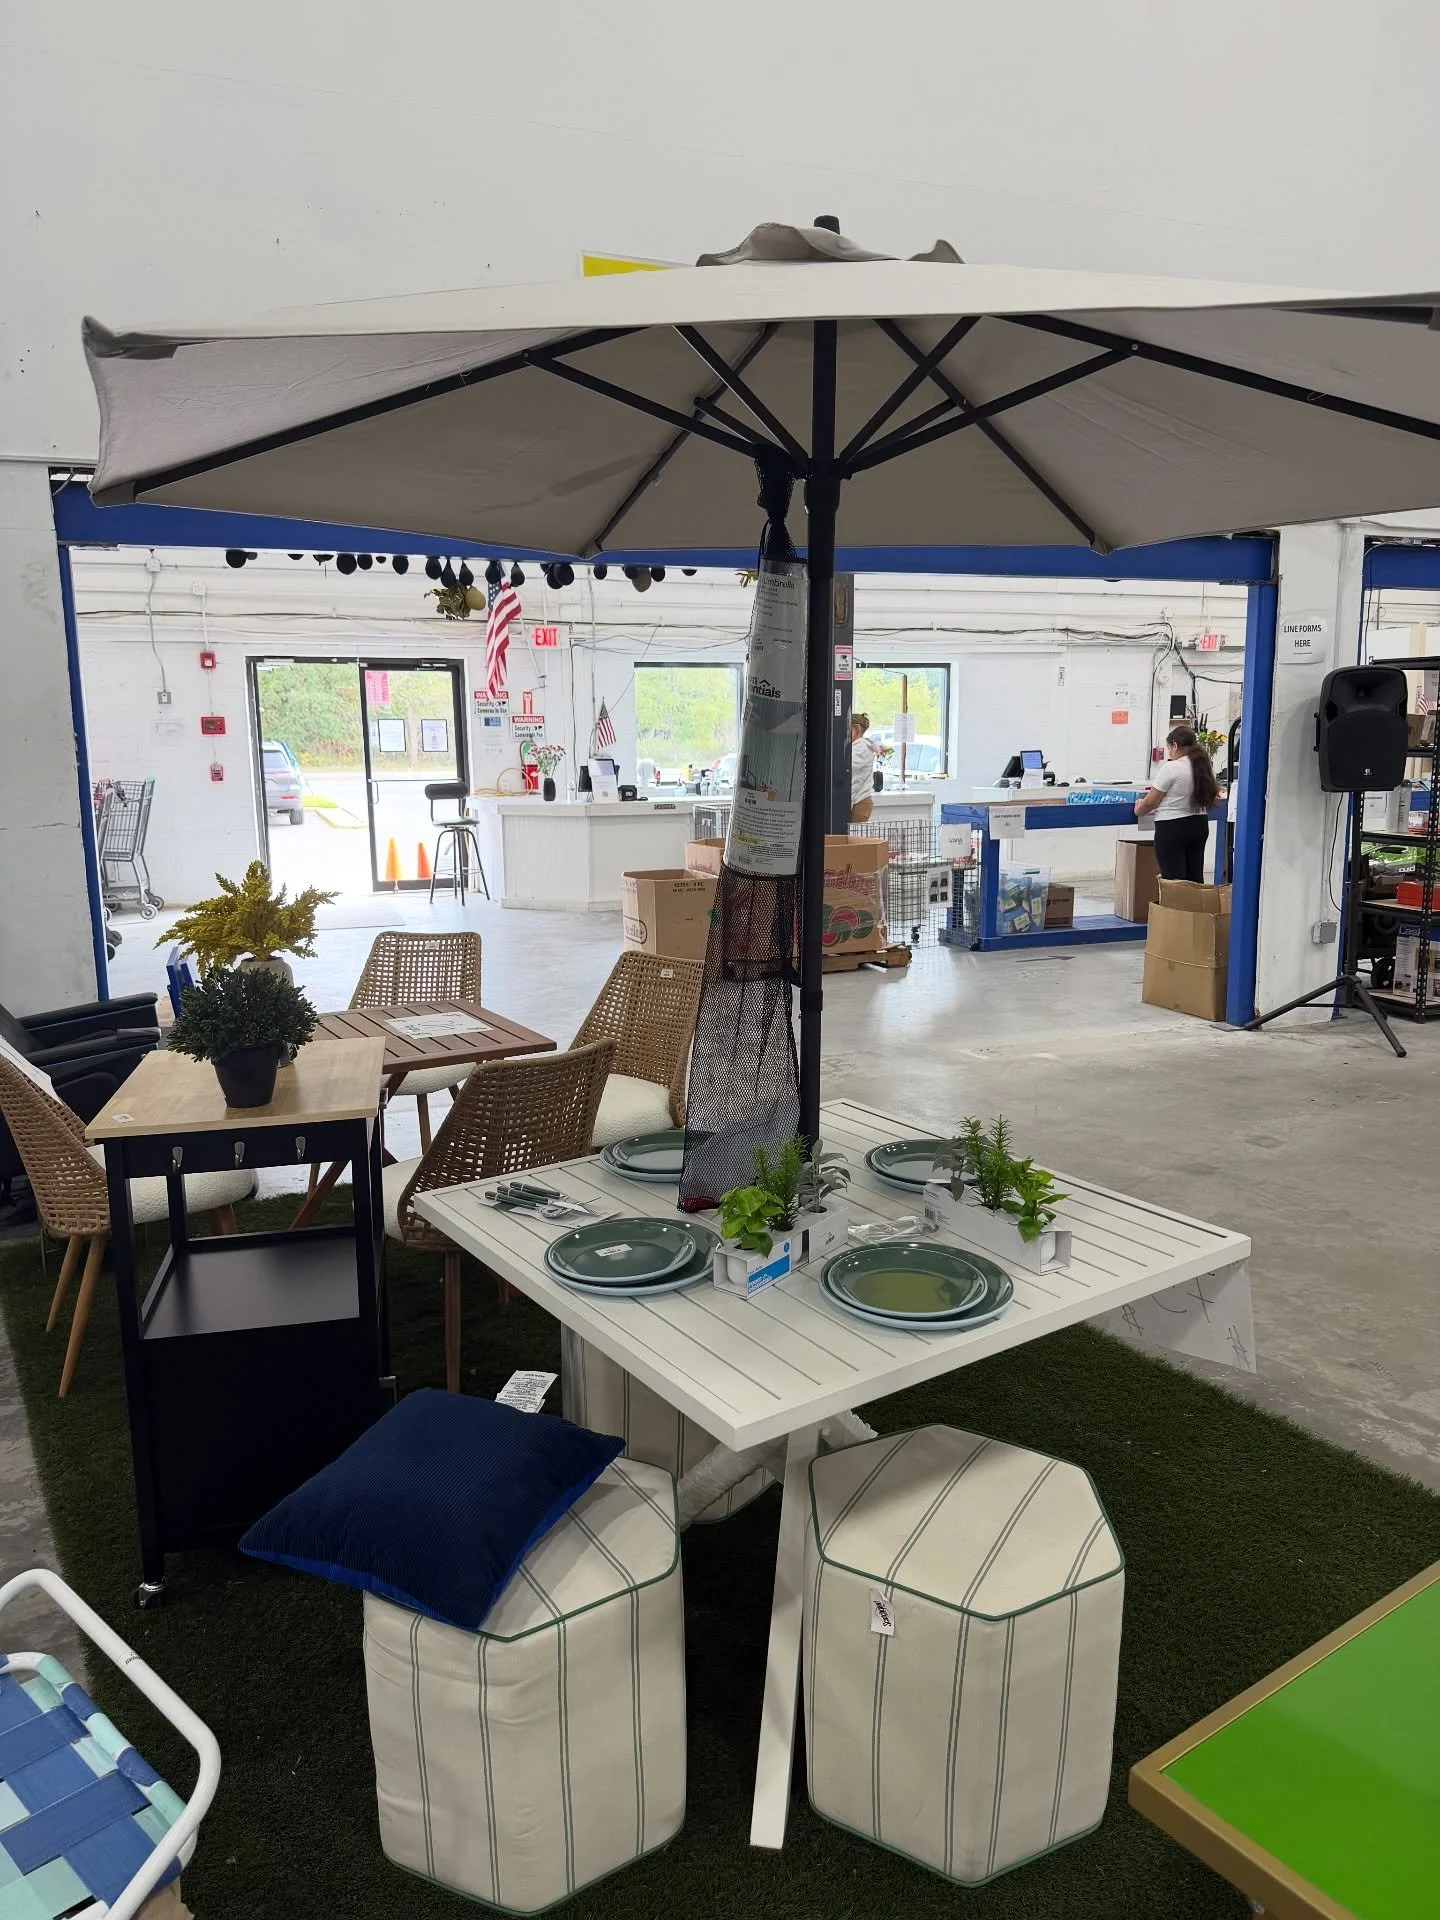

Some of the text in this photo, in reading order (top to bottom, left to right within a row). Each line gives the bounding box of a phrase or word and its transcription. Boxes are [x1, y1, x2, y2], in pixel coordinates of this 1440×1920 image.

[1284, 624, 1322, 633] LINE FORMS
[535, 628, 557, 647] EXIT
[1202, 634, 1219, 649] EXIT
[1294, 639, 1312, 648] HERE
